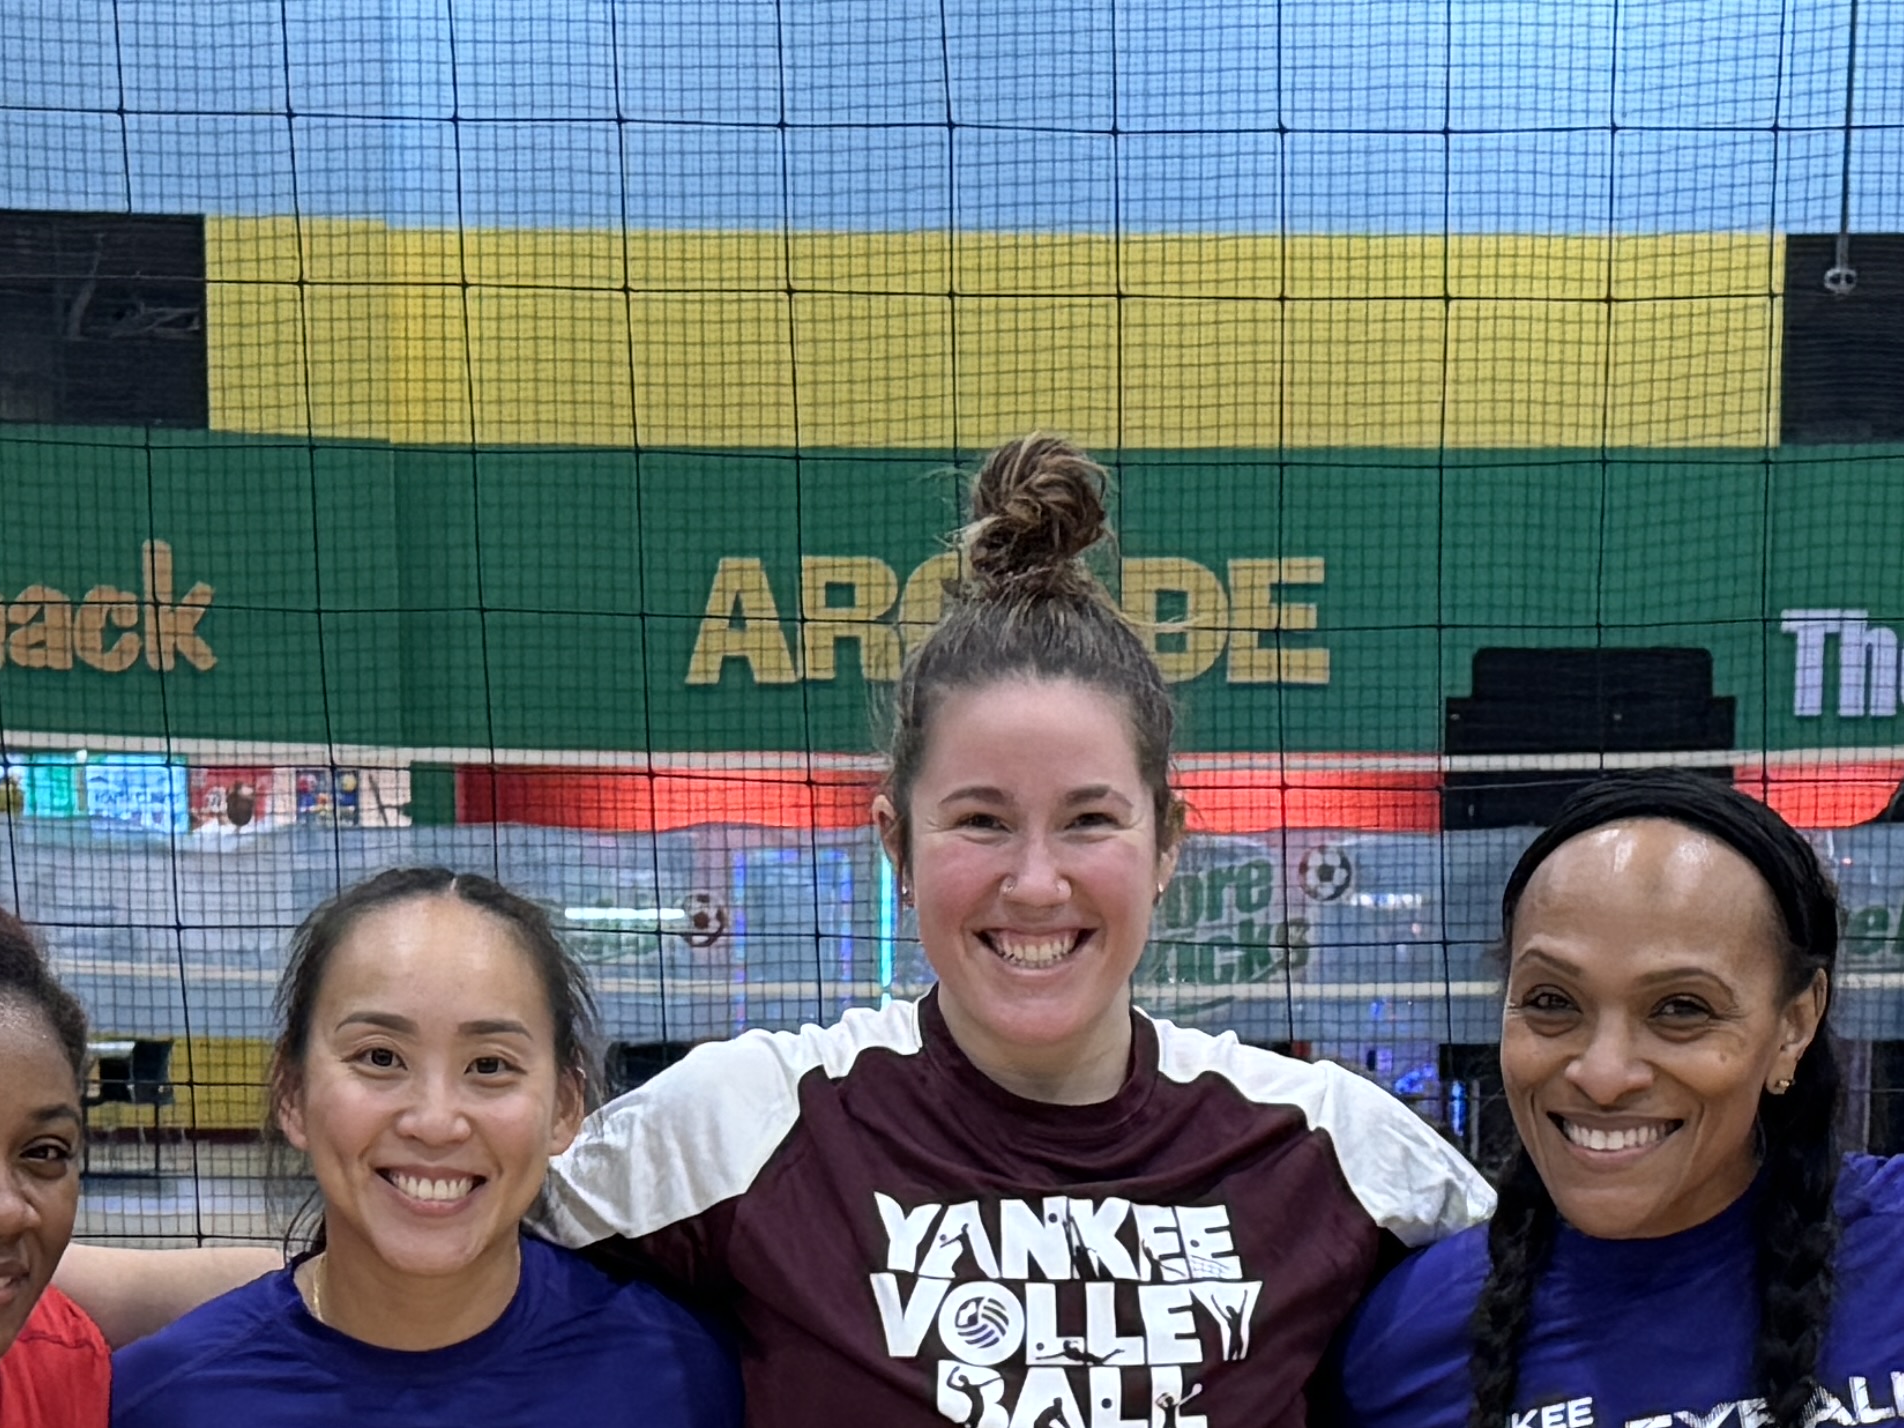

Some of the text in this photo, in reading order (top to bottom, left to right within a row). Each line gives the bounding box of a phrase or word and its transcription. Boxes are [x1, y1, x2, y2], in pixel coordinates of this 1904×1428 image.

[684, 553, 1330, 684] ARDE
[1160, 856, 1273, 930] ore
[873, 1191, 1243, 1282] YANKEE
[869, 1271, 1263, 1367] VOLLEY
